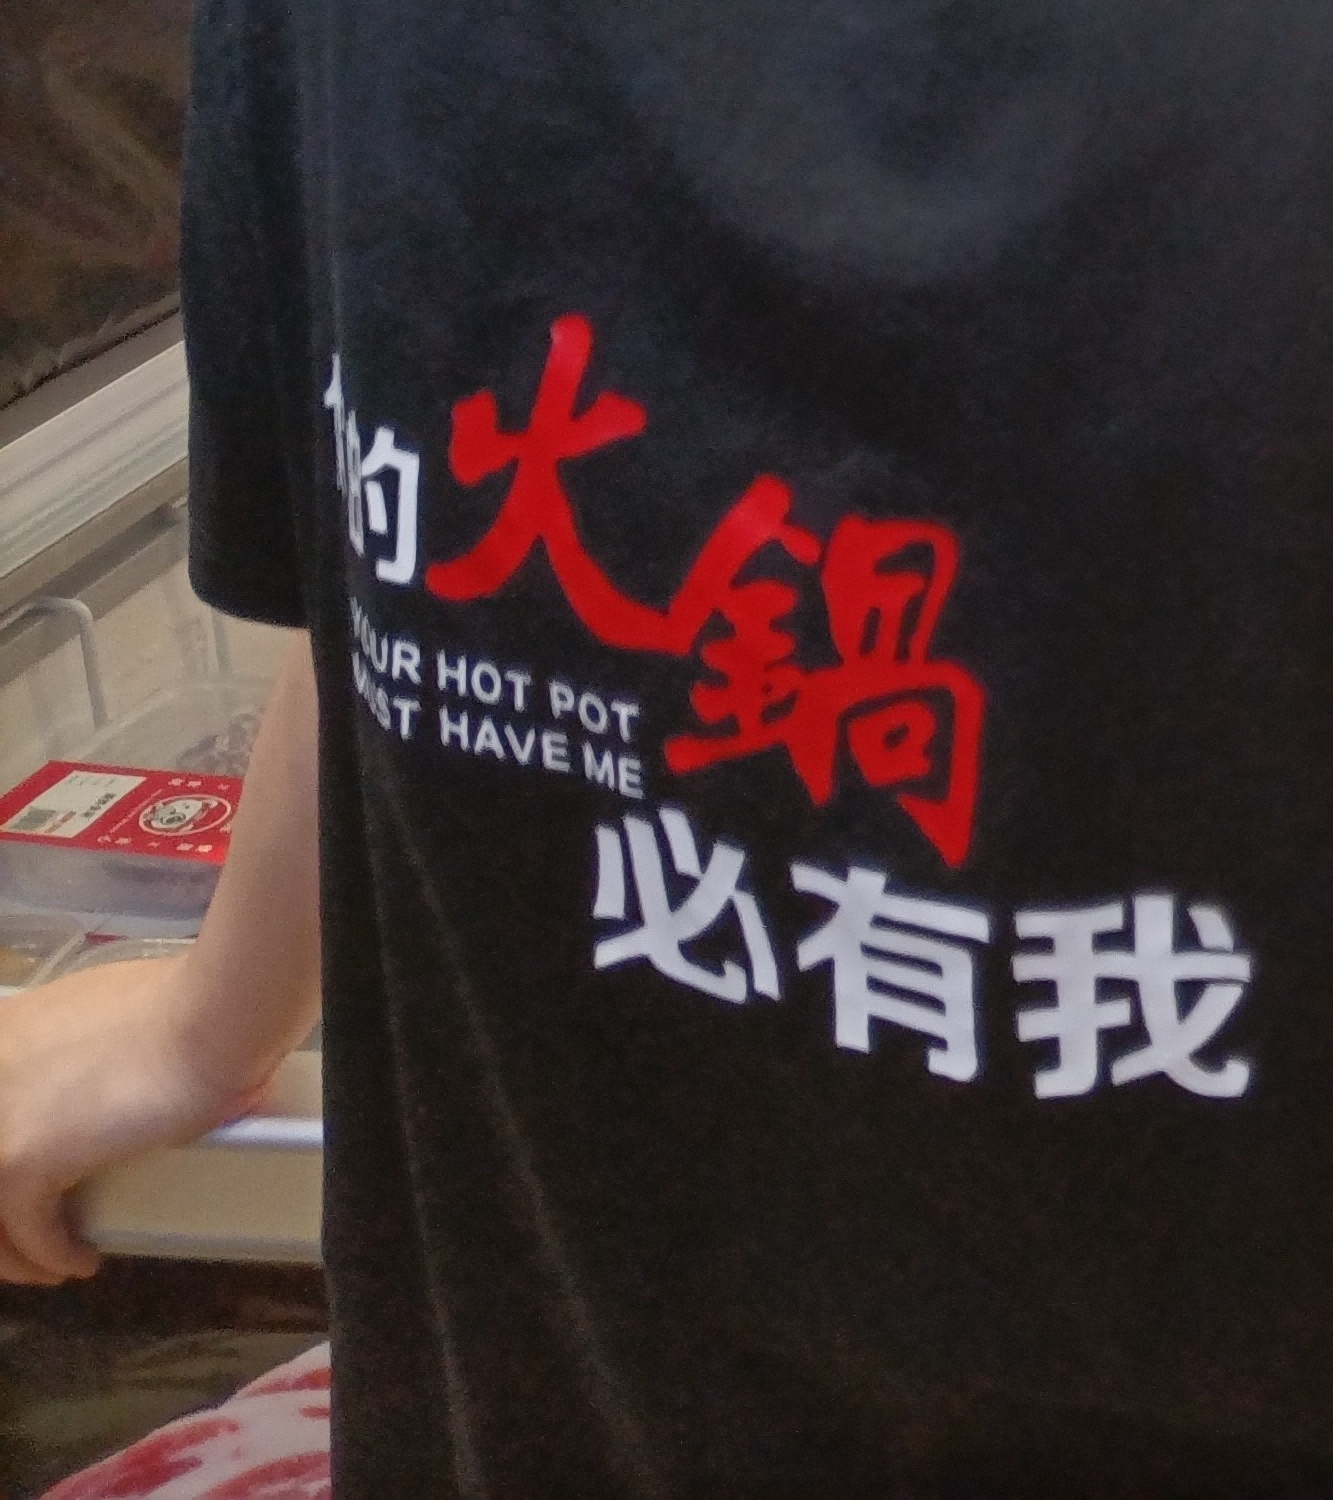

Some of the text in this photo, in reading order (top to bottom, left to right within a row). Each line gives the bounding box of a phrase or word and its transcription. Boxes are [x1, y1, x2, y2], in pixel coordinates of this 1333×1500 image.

[436, 649, 532, 713] HOT
[549, 678, 641, 744] POT
[438, 704, 572, 773] HAVE
[582, 741, 645, 800] ME
[593, 806, 1252, 1100] 必有我
